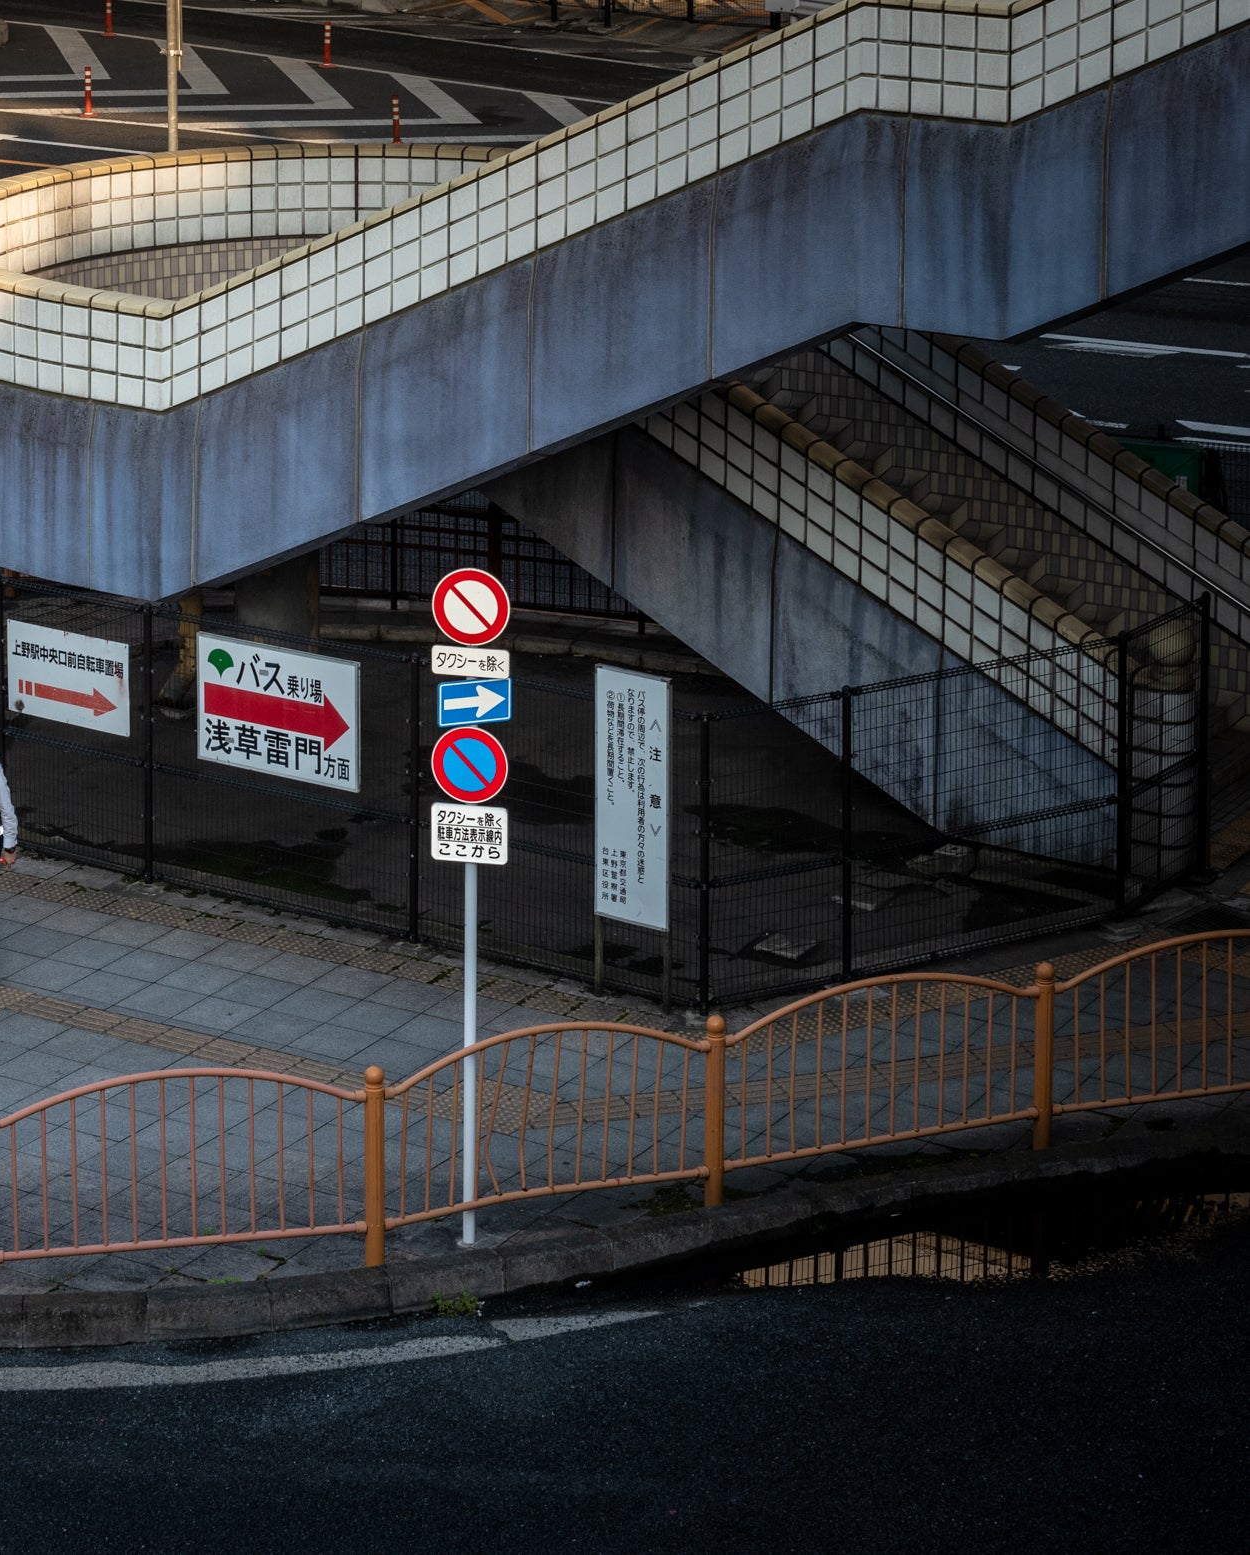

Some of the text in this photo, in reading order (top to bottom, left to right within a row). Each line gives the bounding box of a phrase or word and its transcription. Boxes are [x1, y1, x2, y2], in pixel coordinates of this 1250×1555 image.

[12, 639, 124, 680] 上野駅中央口前自転車置場
[436, 652, 505, 672] タクシーを除く
[236, 653, 323, 704] バス乗り場
[205, 718, 351, 782] 浅草雷門方面
[438, 810, 502, 828] タクシーを除く
[438, 826, 502, 844] 駐車方法表示線内
[439, 843, 501, 859] ここから
[601, 846, 609, 901] 台東区役所
